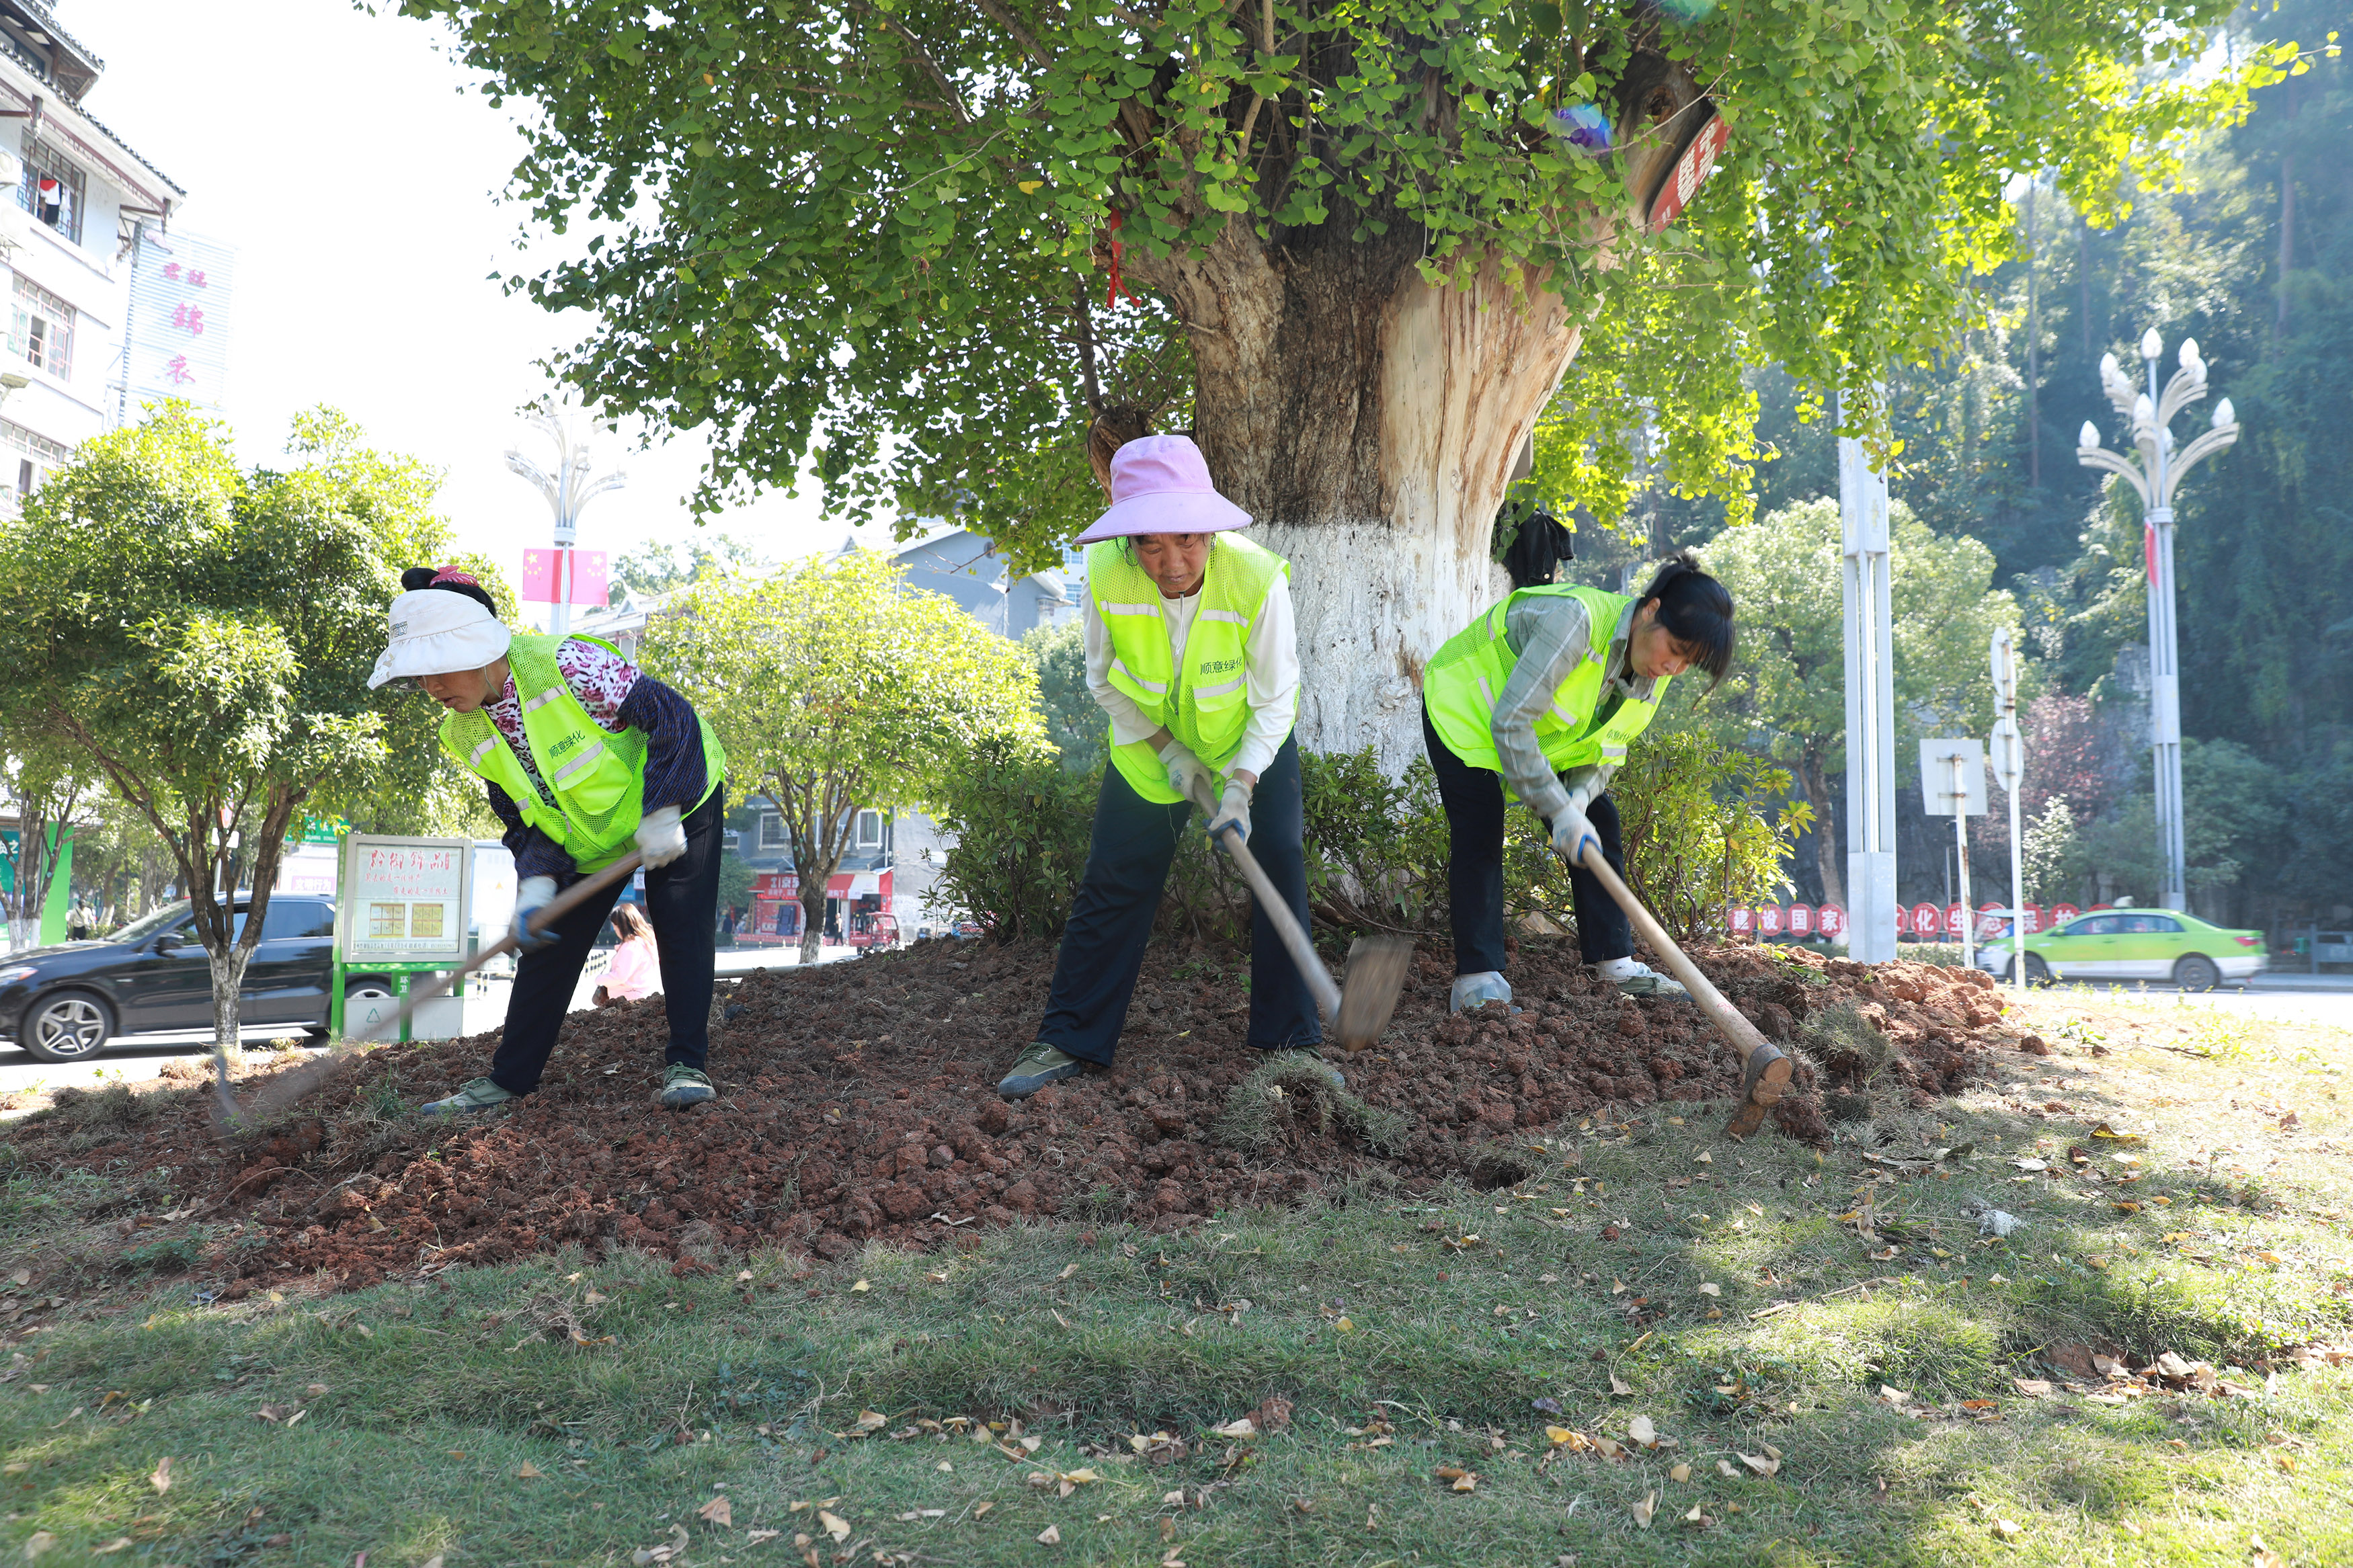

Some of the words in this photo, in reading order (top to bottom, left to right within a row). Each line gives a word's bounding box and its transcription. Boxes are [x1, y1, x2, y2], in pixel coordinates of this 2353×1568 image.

[1200, 656, 1243, 675] 顺意绿化
[548, 730, 586, 759] 顺意绿化
